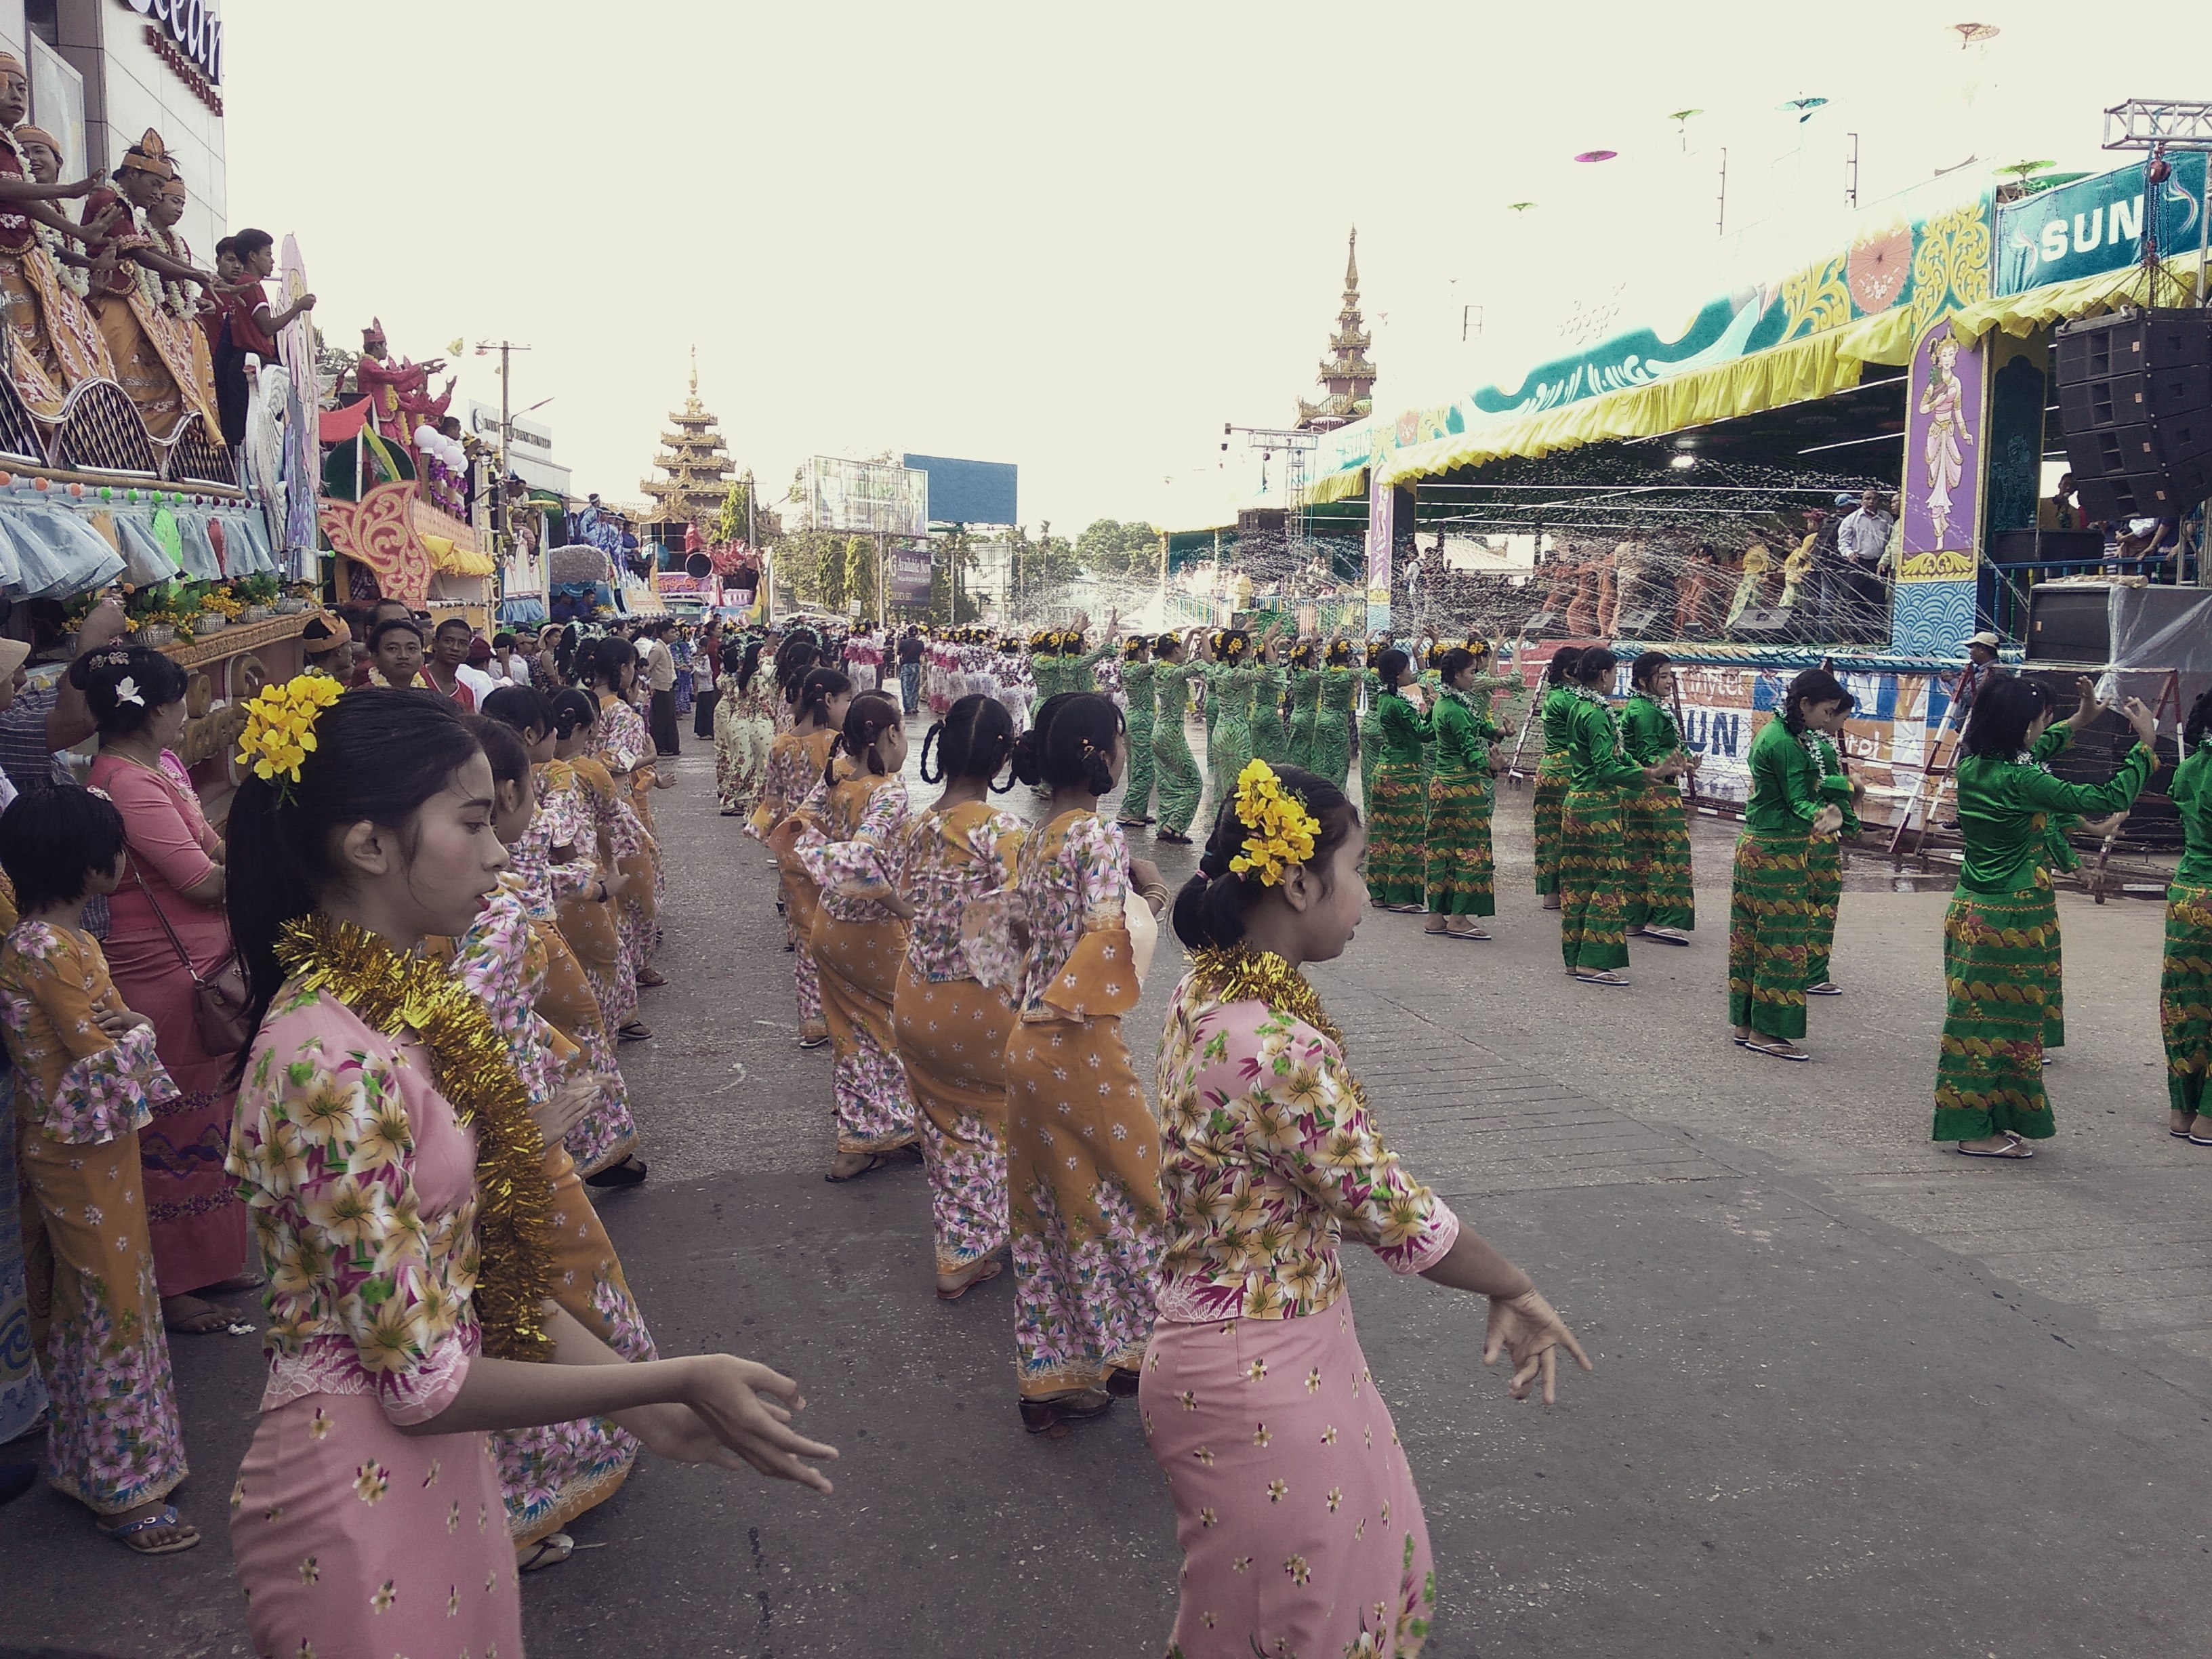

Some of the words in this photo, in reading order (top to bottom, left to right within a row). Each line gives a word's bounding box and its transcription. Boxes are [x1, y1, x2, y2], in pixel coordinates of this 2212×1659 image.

[128, 0, 225, 86] ean
[2041, 194, 2145, 262] SUN
[898, 557, 920, 573] Available
[1689, 670, 1744, 701] Mytel
[1687, 710, 1739, 758] UN
